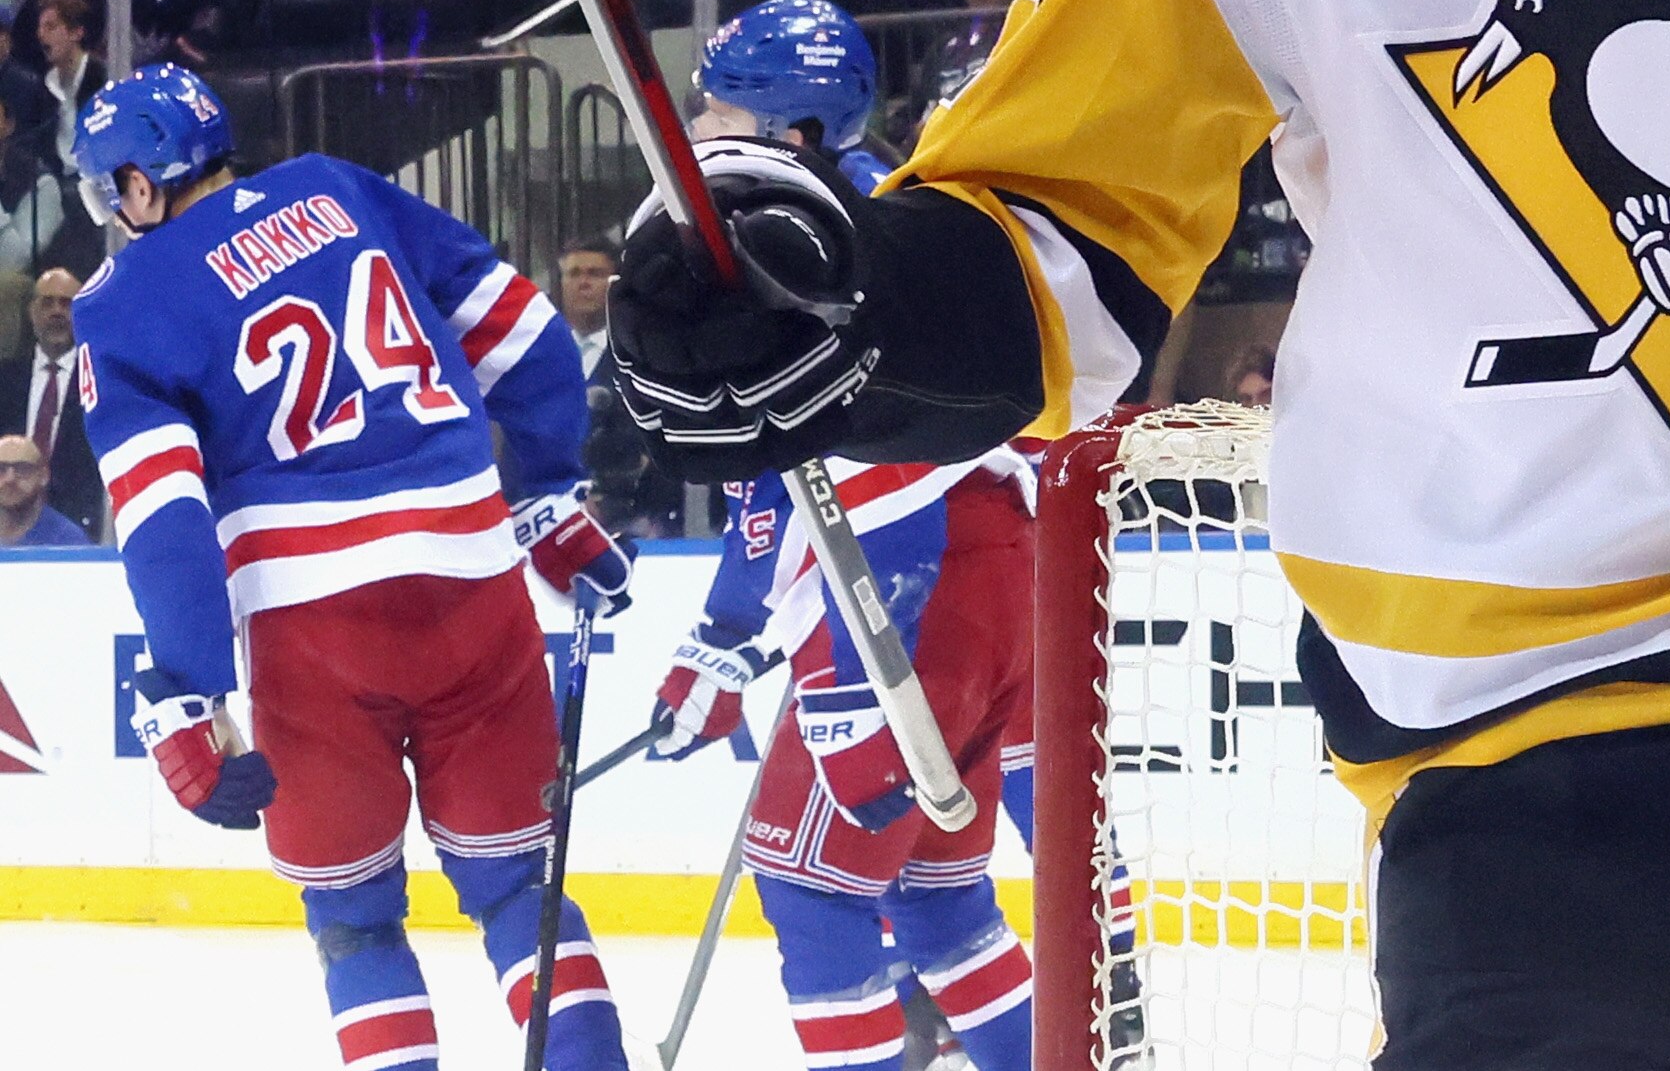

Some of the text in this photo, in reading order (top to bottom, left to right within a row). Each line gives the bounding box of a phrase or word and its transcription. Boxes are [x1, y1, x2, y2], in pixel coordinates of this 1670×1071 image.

[205, 194, 359, 301] KAKKO
[233, 248, 470, 462] 24
[801, 457, 842, 528] CCM
